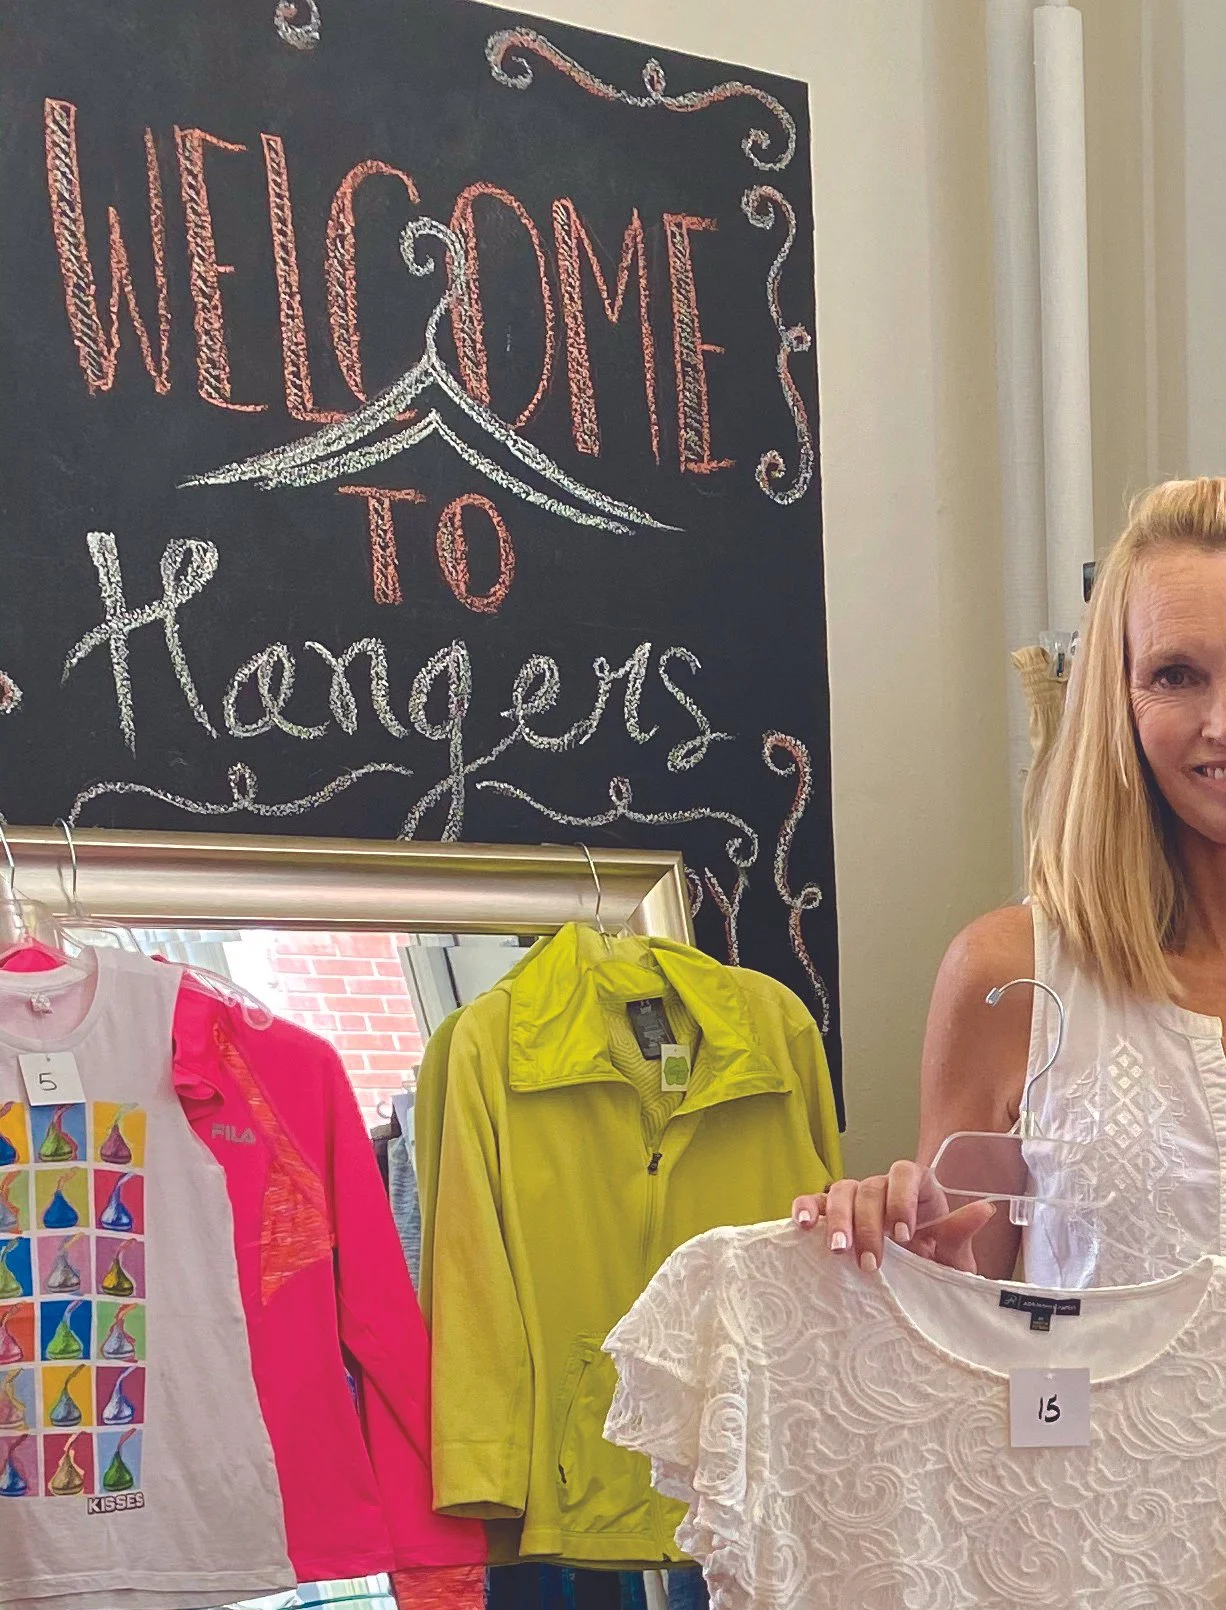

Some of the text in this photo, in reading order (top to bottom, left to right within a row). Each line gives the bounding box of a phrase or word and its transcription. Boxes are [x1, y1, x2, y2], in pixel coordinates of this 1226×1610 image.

[44, 98, 738, 475] WELCOME
[338, 486, 517, 613] TO
[61, 531, 738, 842] Hangers
[38, 1071, 58, 1092] 5
[211, 1122, 257, 1145] FILA
[1038, 1393, 1061, 1423] 15
[88, 1491, 145, 1514] KISSES
